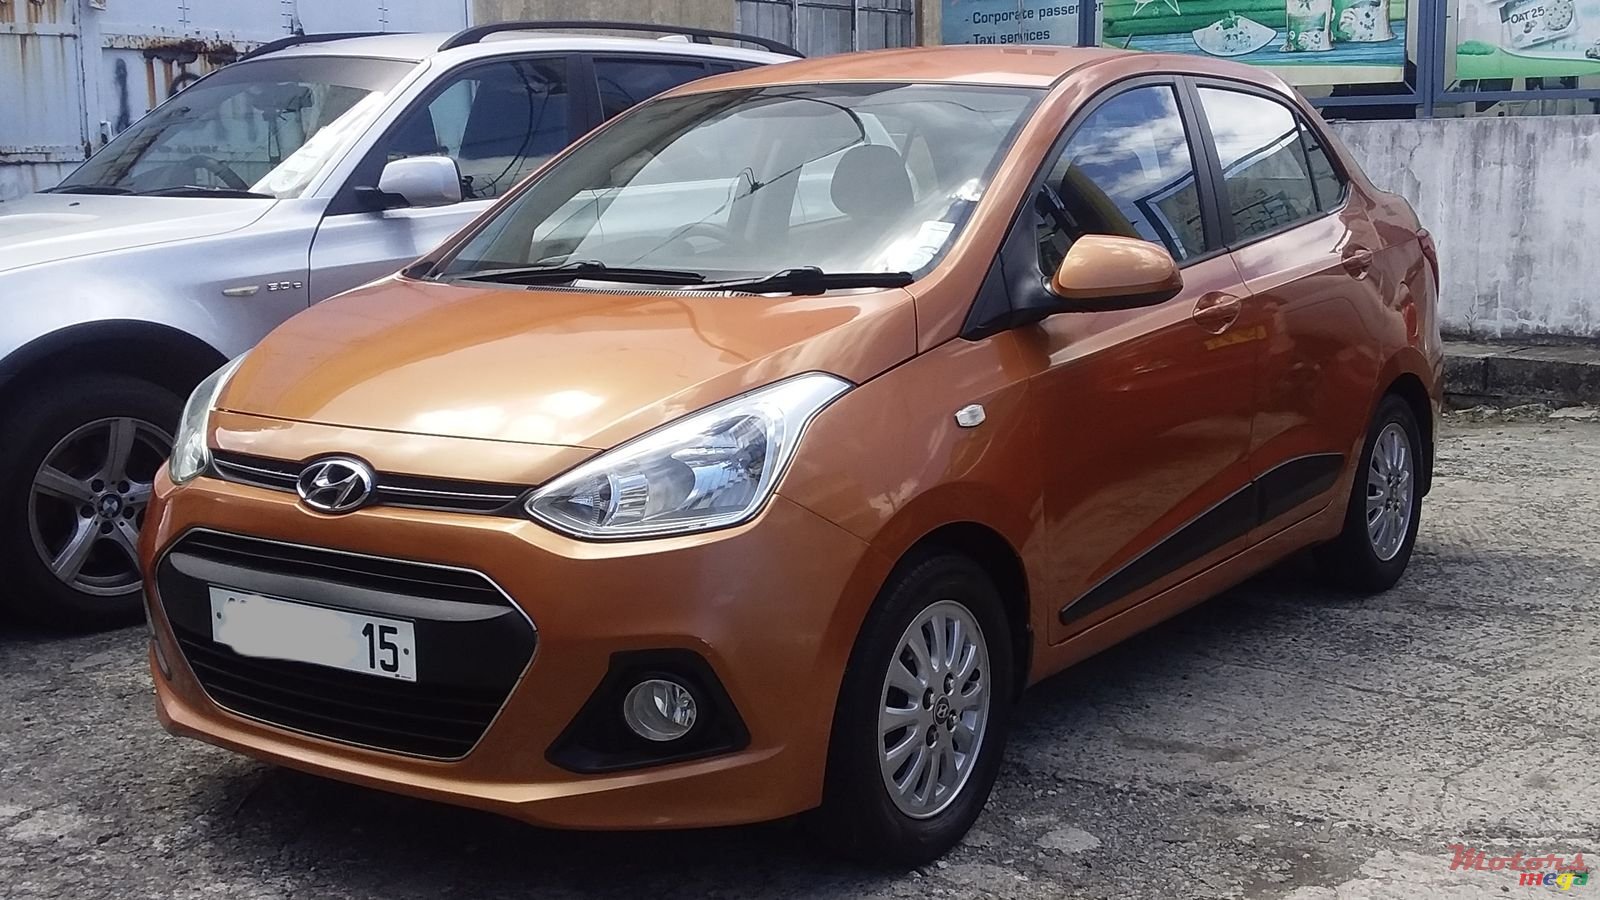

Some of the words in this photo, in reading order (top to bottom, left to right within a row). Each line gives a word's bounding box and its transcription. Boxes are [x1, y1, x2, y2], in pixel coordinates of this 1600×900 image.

[973, 9, 1034, 25] Corporate
[973, 32, 996, 44] Taxi
[1000, 29, 1050, 44] services
[362, 622, 399, 673] 15
